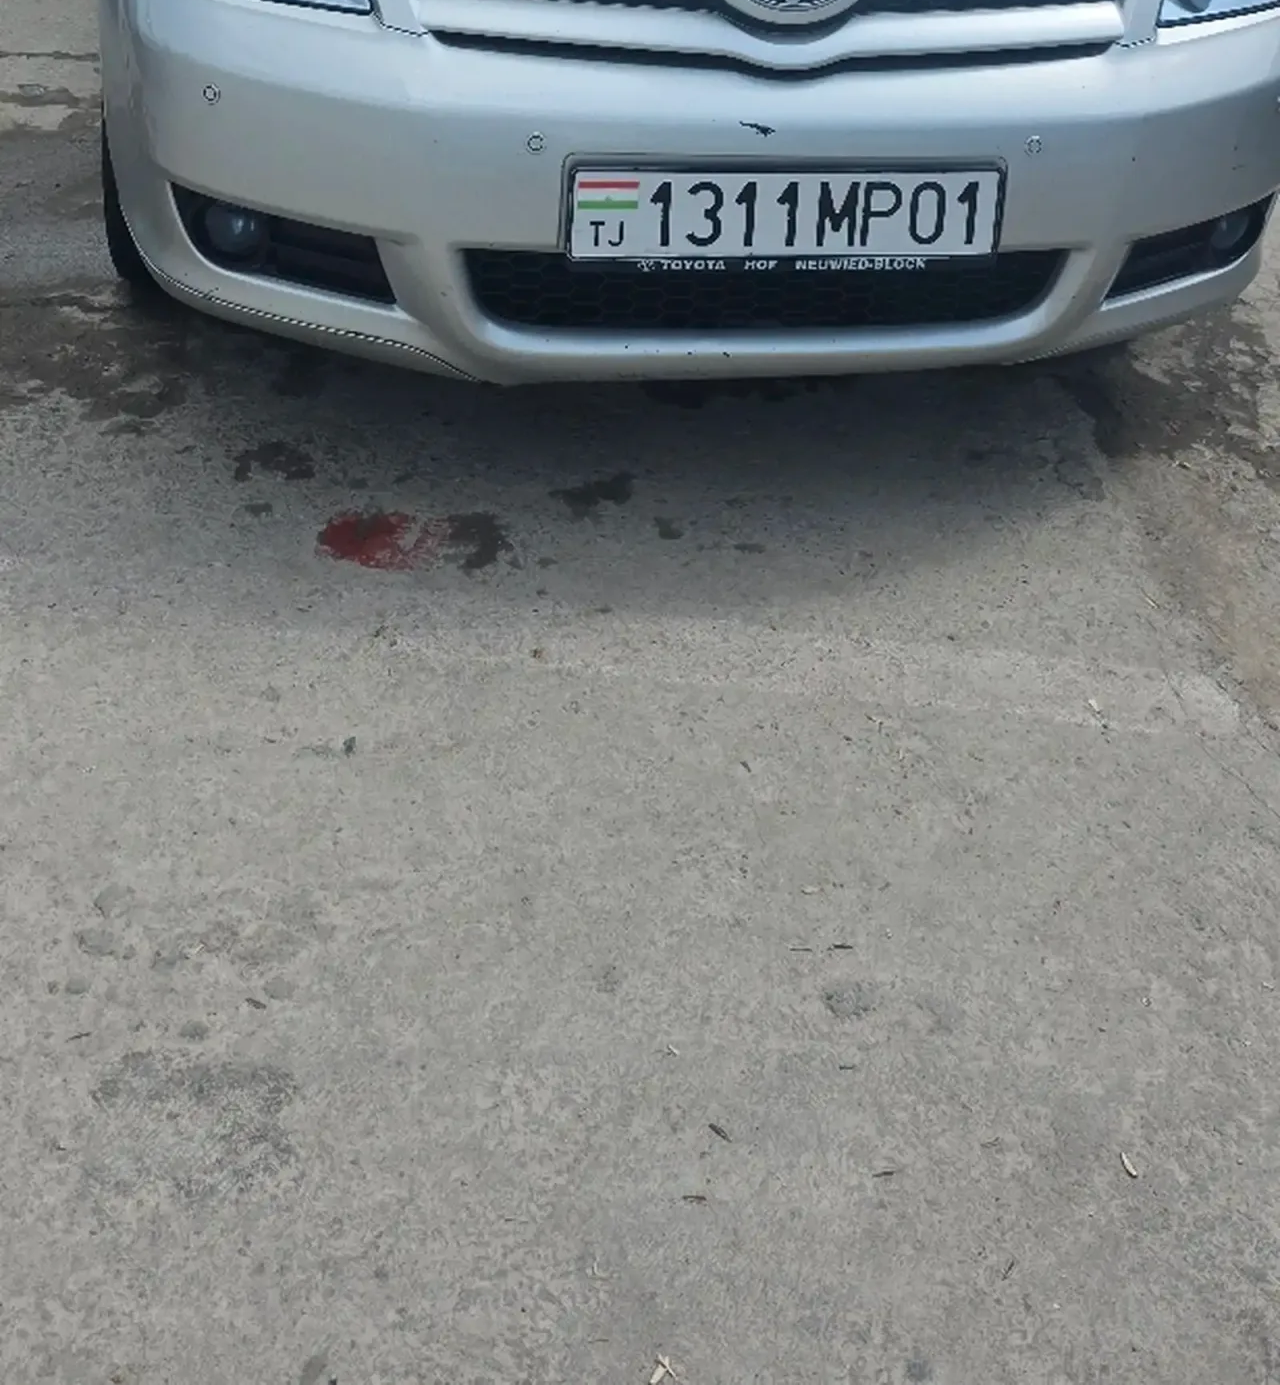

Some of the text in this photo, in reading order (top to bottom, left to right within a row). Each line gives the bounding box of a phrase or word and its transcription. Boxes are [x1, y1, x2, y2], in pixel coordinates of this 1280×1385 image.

[650, 181, 980, 247] 1311MP01
[589, 220, 625, 247] TJ
[660, 257, 927, 271] TOYOTA HOF NEUWIED-BLOCK
